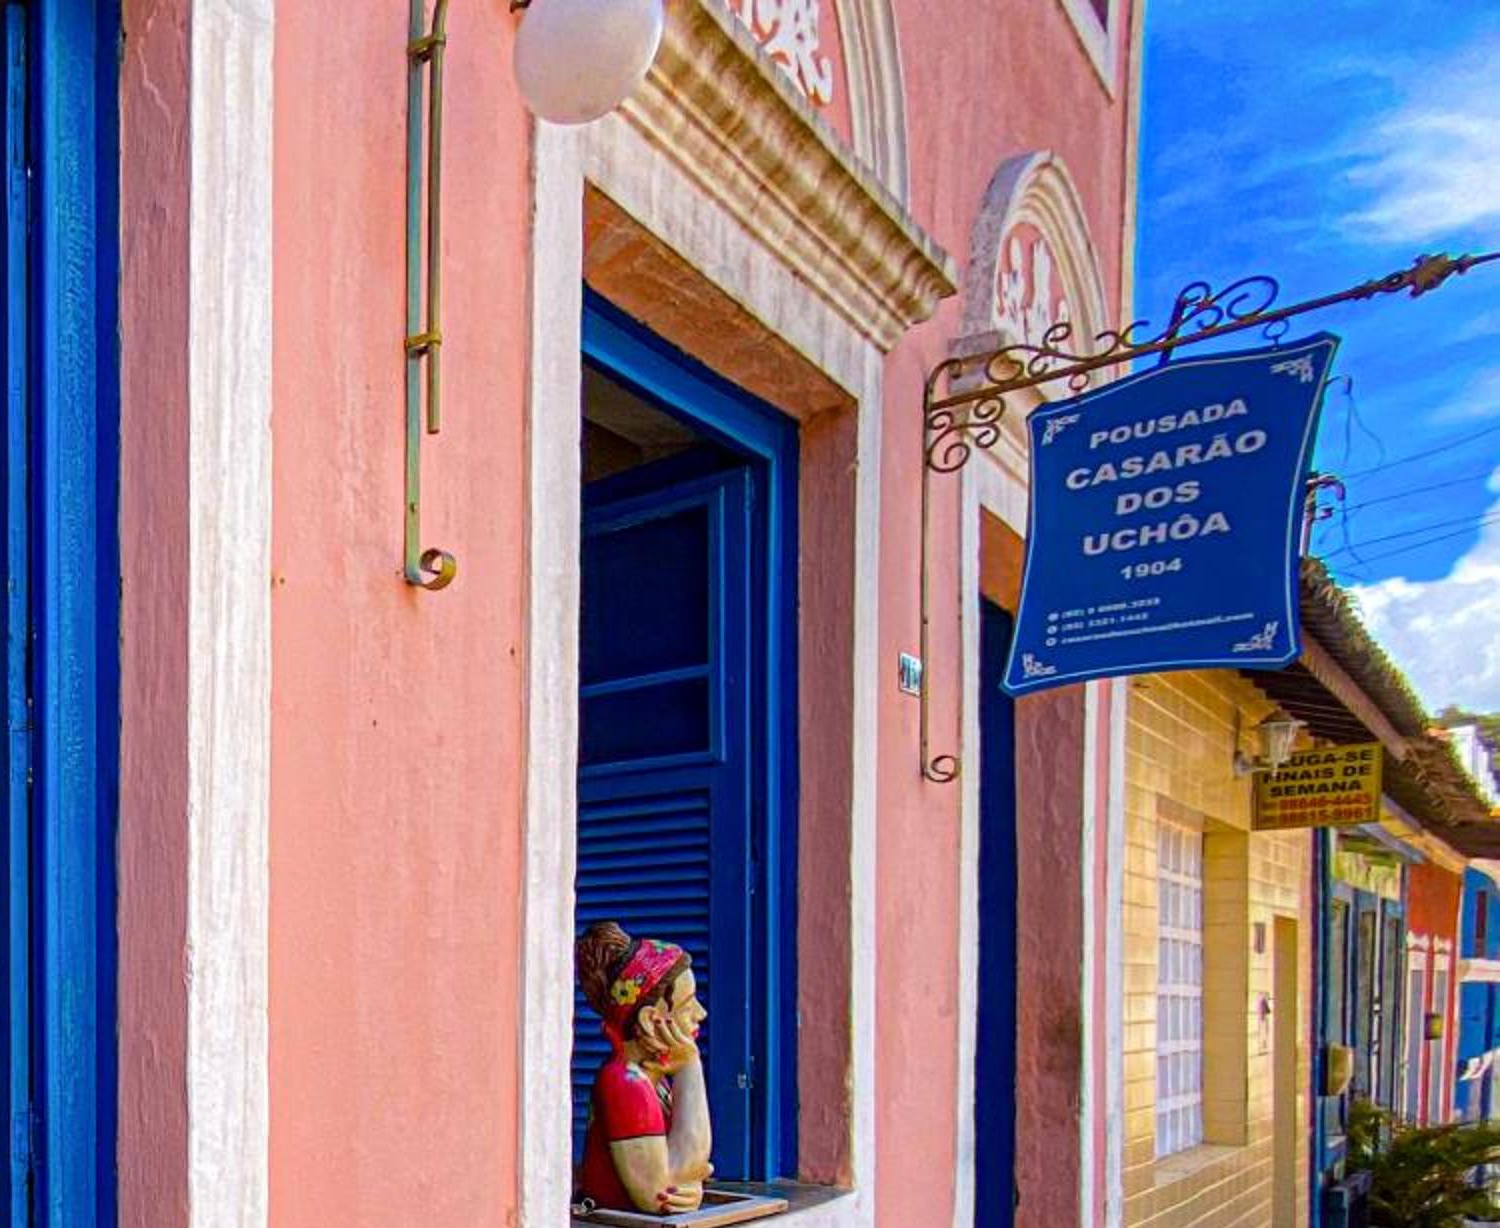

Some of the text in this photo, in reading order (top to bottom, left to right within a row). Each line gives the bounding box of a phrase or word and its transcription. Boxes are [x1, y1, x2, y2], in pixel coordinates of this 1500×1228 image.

[1089, 399, 1248, 449] POUSADA
[1065, 430, 1267, 490] CASARÃO
[1115, 481, 1201, 515] DOS
[1082, 512, 1231, 555] UCHÔA
[1120, 557, 1183, 579] 1904
[1263, 749, 1374, 769] LUGA-SE
[1343, 764, 1372, 777] DE
[1268, 780, 1363, 797] SEMANA
